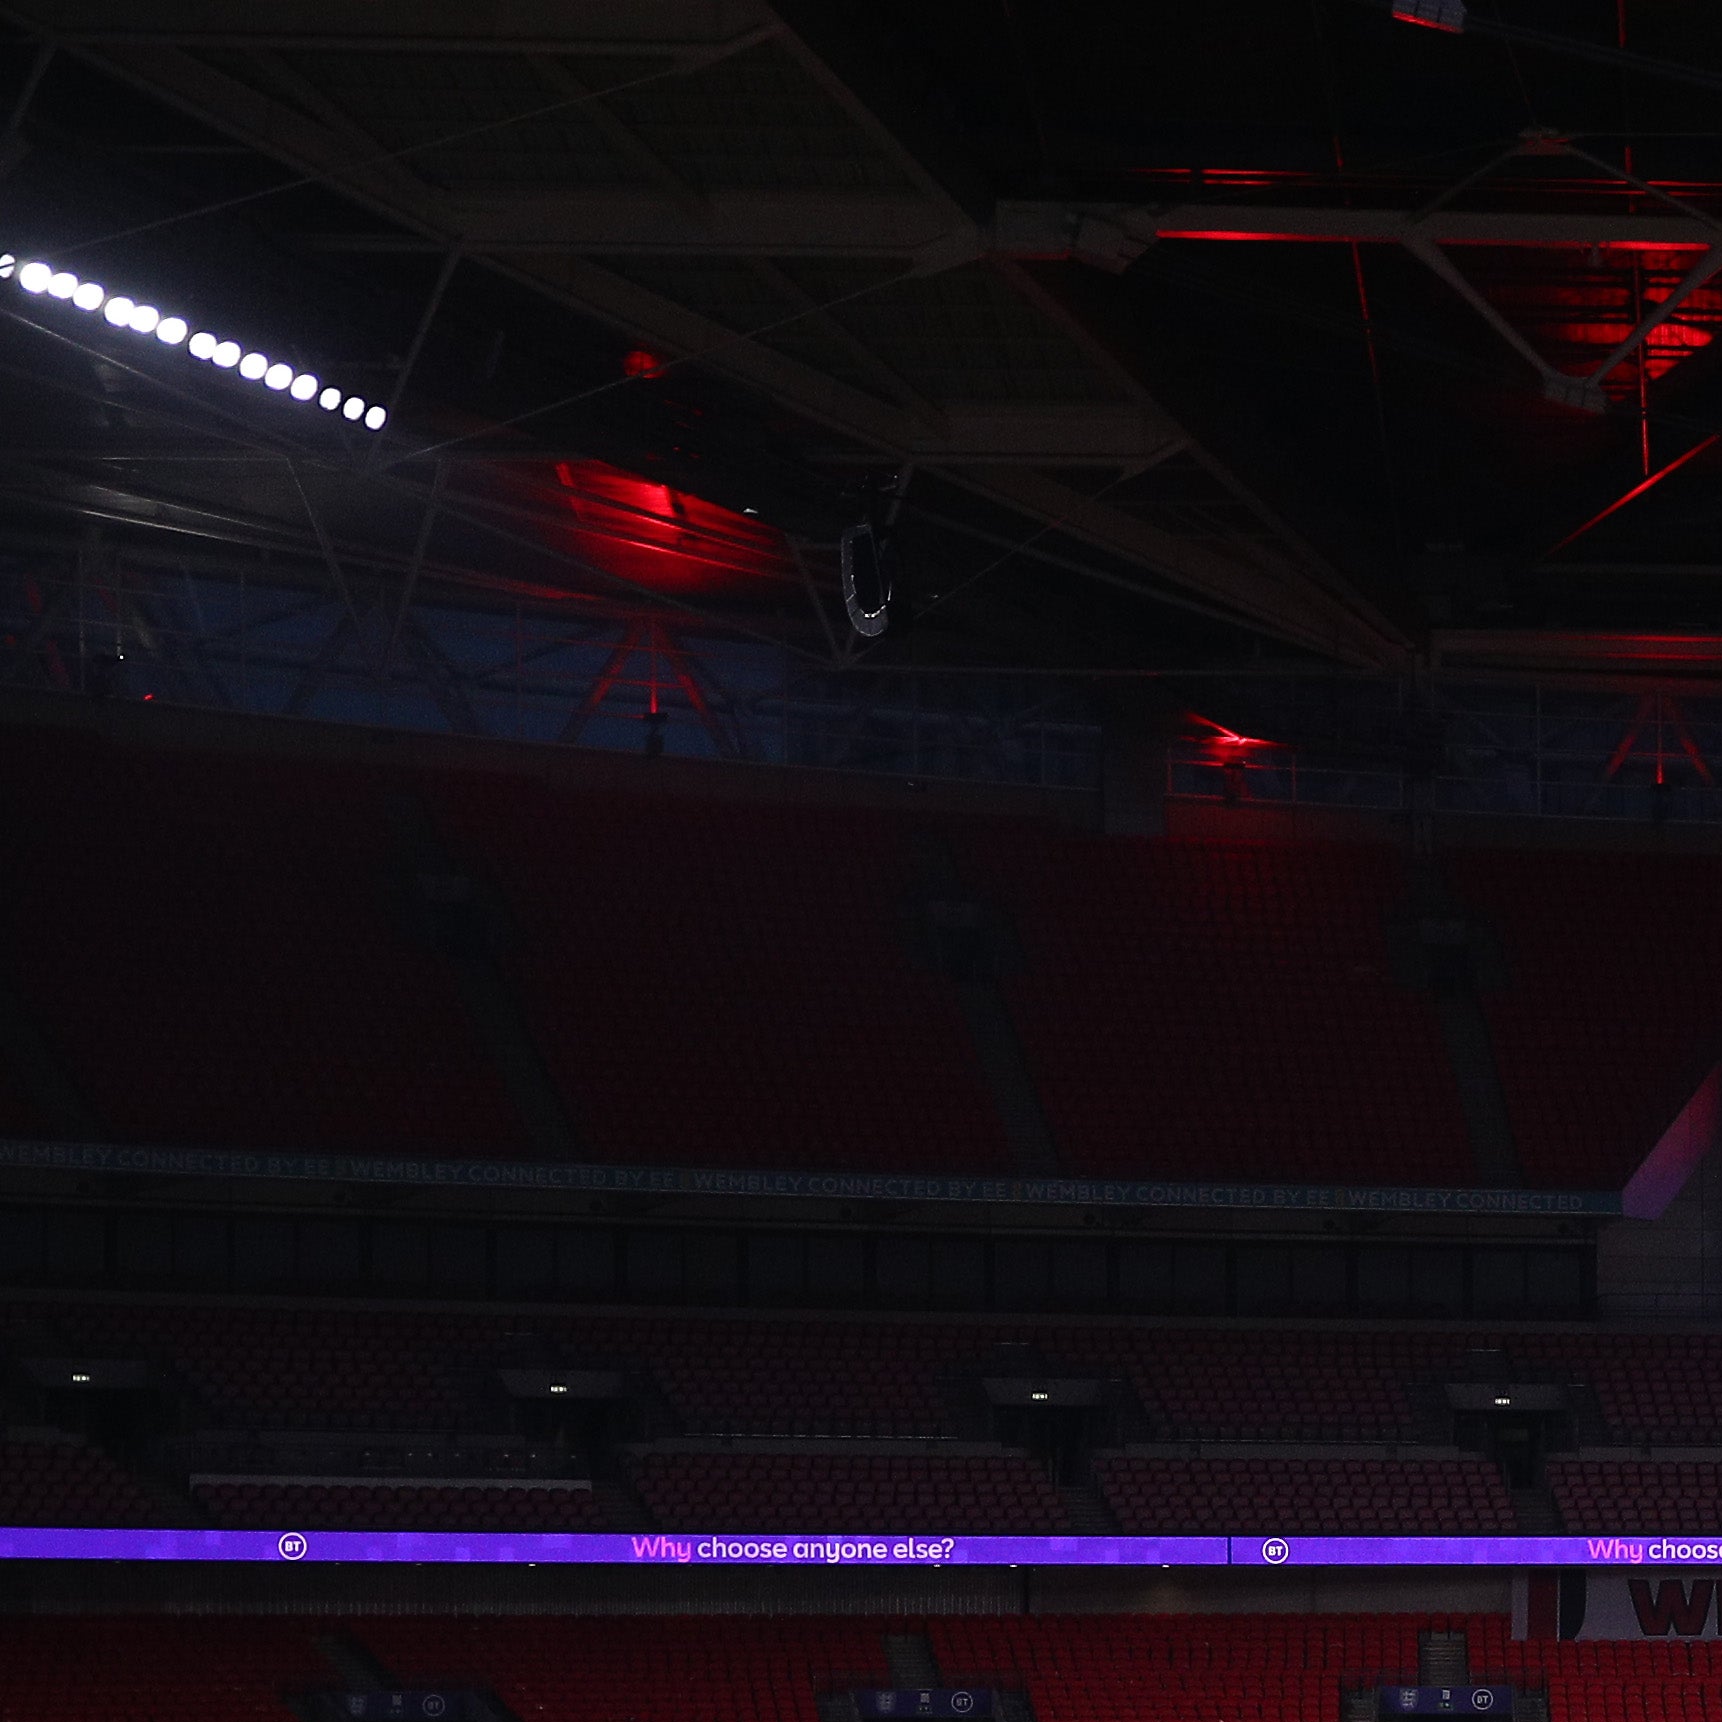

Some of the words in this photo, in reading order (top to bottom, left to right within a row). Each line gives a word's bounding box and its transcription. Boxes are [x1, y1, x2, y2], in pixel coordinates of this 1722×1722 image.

[3, 1144, 117, 1164] WEMBLEY
[119, 1149, 258, 1170] CONNECTED
[268, 1158, 294, 1171] BY
[305, 1159, 328, 1173] EE
[350, 1160, 464, 1180] WEMBLEY
[468, 1166, 607, 1183] CONNECTED
[616, 1170, 644, 1184] BY
[650, 1171, 673, 1186] EE
[695, 1173, 800, 1190] WEMBLEY
[808, 1178, 940, 1194] CONNECTED
[949, 1181, 976, 1197] BY
[982, 1182, 1006, 1198] EE
[1026, 1182, 1128, 1200] WEMBLEY
[1135, 1185, 1266, 1203] CONNECTED
[1276, 1190, 1301, 1204] BY
[1308, 1191, 1329, 1205] EE
[1349, 1190, 1451, 1208] WEMBLEY
[1456, 1193, 1582, 1209] CONNECTED
[285, 1541, 301, 1551] BT
[631, 1537, 691, 1563] Why
[698, 1537, 787, 1559] choose
[793, 1543, 887, 1563] anyone
[893, 1538, 954, 1559] else?
[1268, 1545, 1283, 1556] BT
[1588, 1539, 1643, 1563] Why
